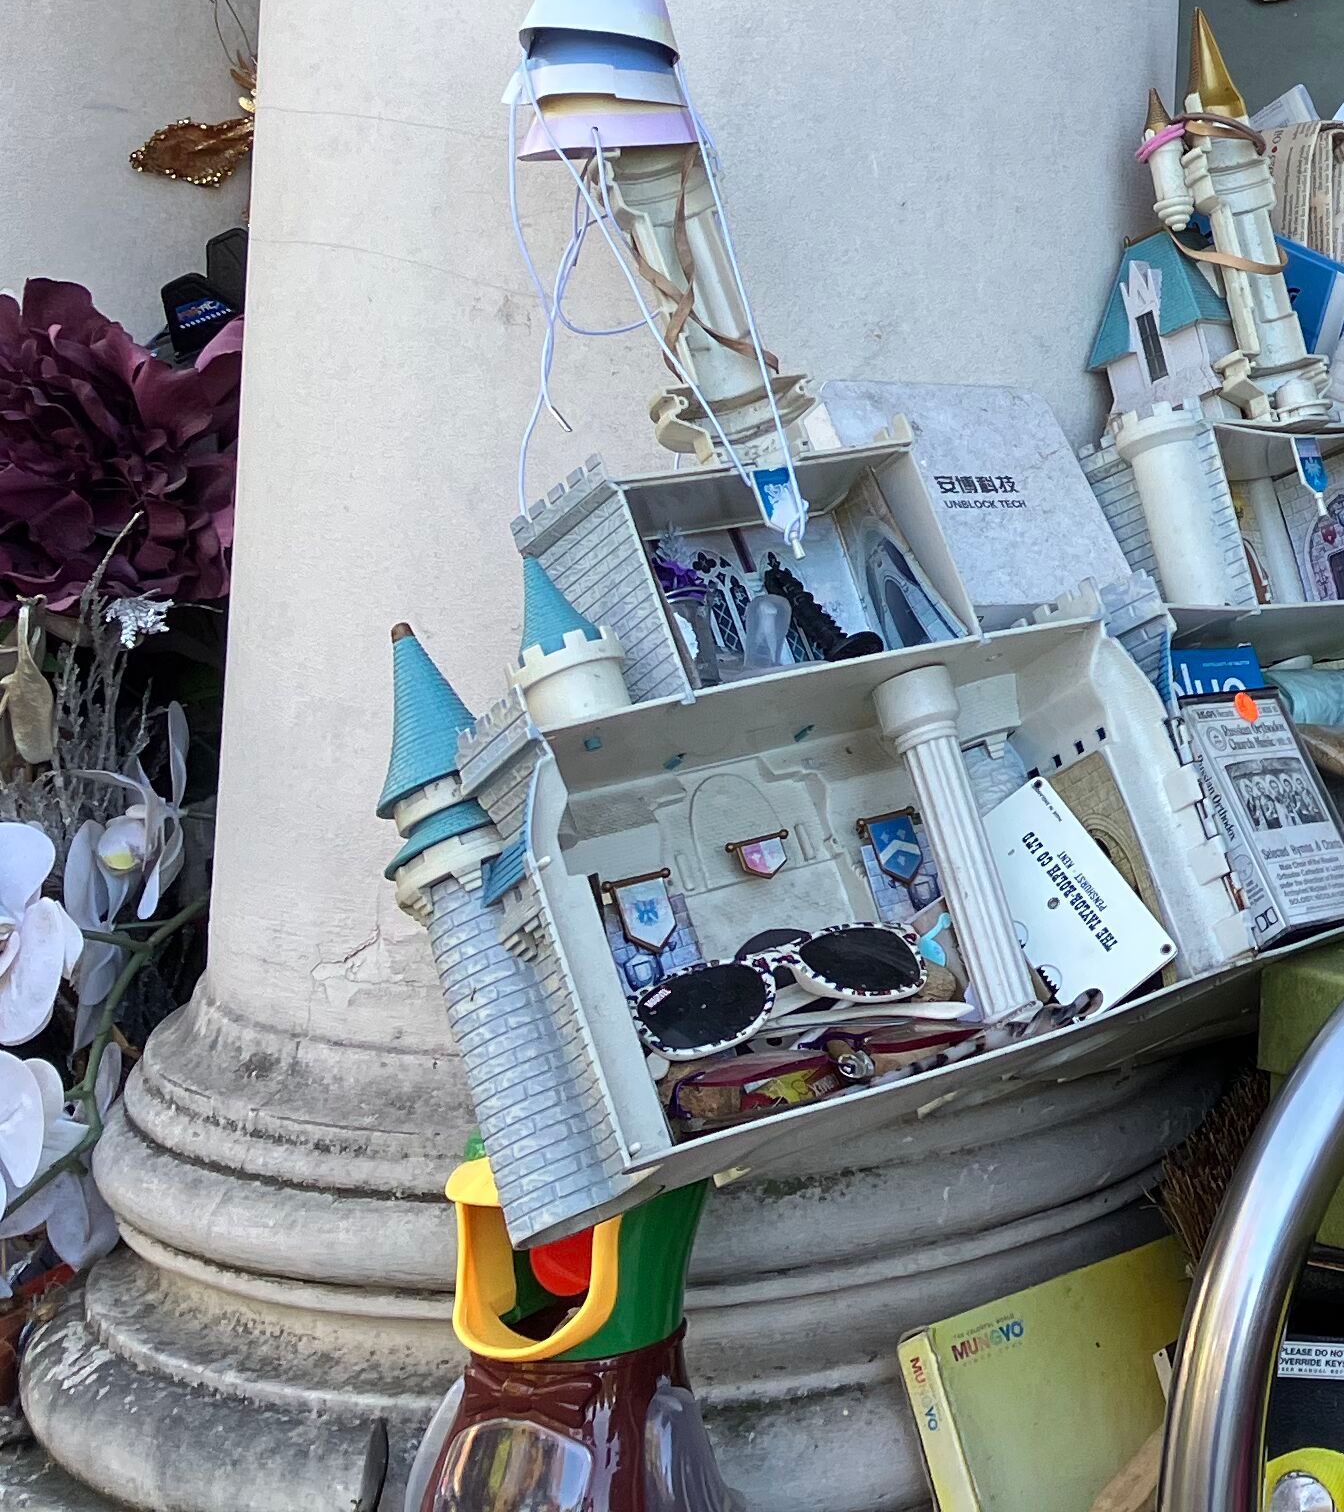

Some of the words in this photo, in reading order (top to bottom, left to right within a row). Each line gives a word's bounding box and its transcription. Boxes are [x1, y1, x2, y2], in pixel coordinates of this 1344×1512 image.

[944, 499, 998, 509] UNBLOCK
[998, 499, 1027, 509] TECH
[1212, 793, 1236, 842] Orthodox
[1022, 831, 1044, 855] LTD
[1036, 851, 1054, 867] CO
[1056, 850, 1075, 870] KENT
[1046, 863, 1103, 931] TAYLOR-ROLPH
[1073, 872, 1108, 913] PENSHURST
[1094, 926, 1118, 953] THE
[950, 1320, 1025, 1363] MUNGYO
[1314, 1349, 1329, 1357] DO
